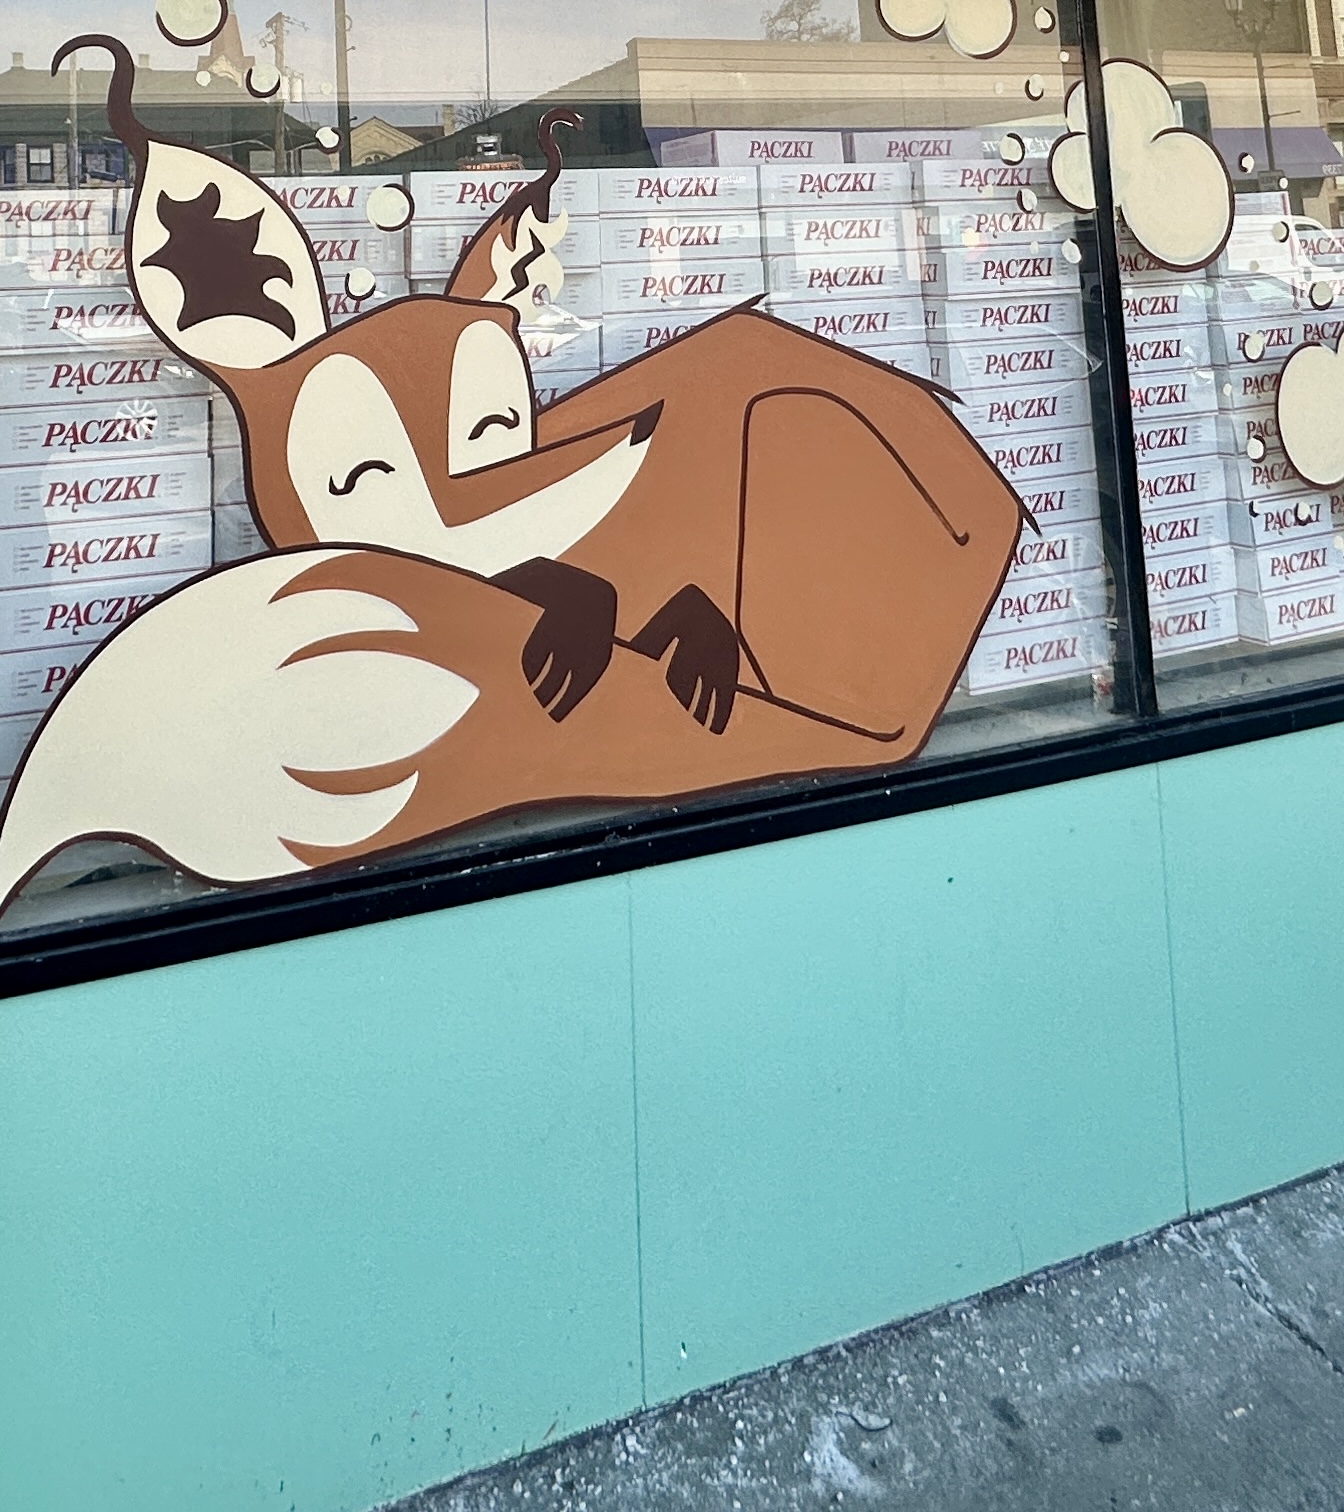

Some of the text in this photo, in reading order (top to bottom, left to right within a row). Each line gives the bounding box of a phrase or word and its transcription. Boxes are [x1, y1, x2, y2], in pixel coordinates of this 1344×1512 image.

[749, 140, 814, 163] PĄCZKI
[635, 177, 719, 204] PĄCZKI
[798, 172, 876, 198] PĄCZKI
[959, 168, 1033, 193] PĄCZKI
[637, 226, 722, 253] PĄCZKI
[804, 219, 882, 246] PĄCZKI
[975, 212, 1046, 239] PĄCZKI
[48, 247, 126, 278] PĄCZ
[981, 257, 1054, 285] PĄCZKI
[640, 273, 726, 303] PĄCZKI
[807, 265, 886, 293] PĄCZKI
[980, 303, 1052, 332] PĄCZKI
[49, 358, 164, 394] PĄCZKI
[984, 350, 1055, 379] PĄCZKI
[987, 396, 1058, 427] PĄCZKI
[994, 442, 1063, 474] PĄCZKI
[43, 474, 160, 513] PĄCZKI
[42, 533, 161, 573] PĄCZKI
[1270, 548, 1327, 580] PĄCZKI
[999, 588, 1072, 623] PĄCZKI
[1278, 594, 1336, 630] PĄCZKI
[1004, 637, 1078, 672] PĄCZKI
